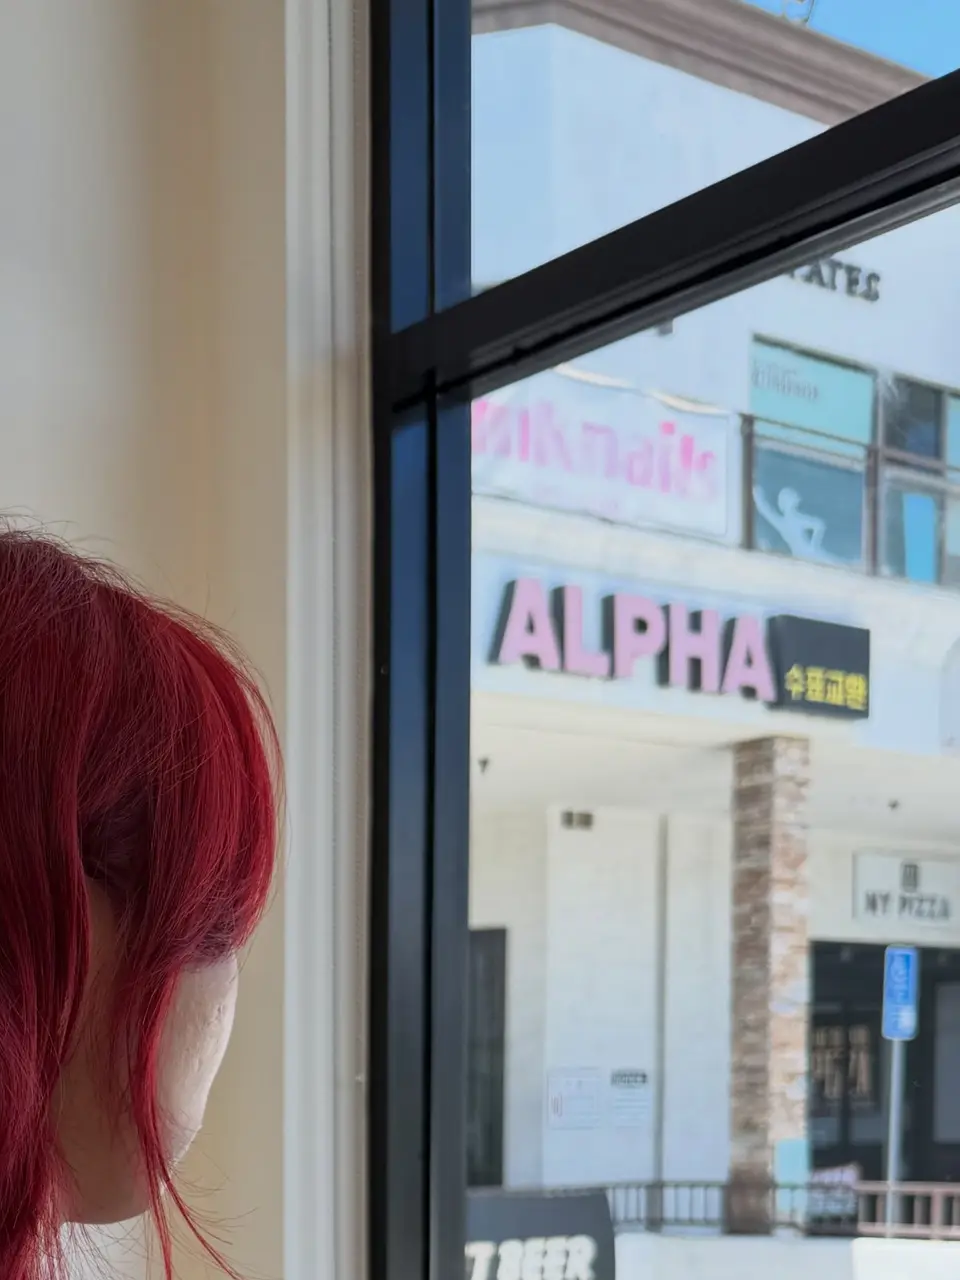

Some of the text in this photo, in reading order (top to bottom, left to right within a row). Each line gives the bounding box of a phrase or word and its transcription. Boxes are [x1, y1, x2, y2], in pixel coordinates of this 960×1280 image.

[788, 256, 881, 302] ATES
[488, 577, 777, 702] ALPHA
[899, 894, 951, 920] PIZZA
